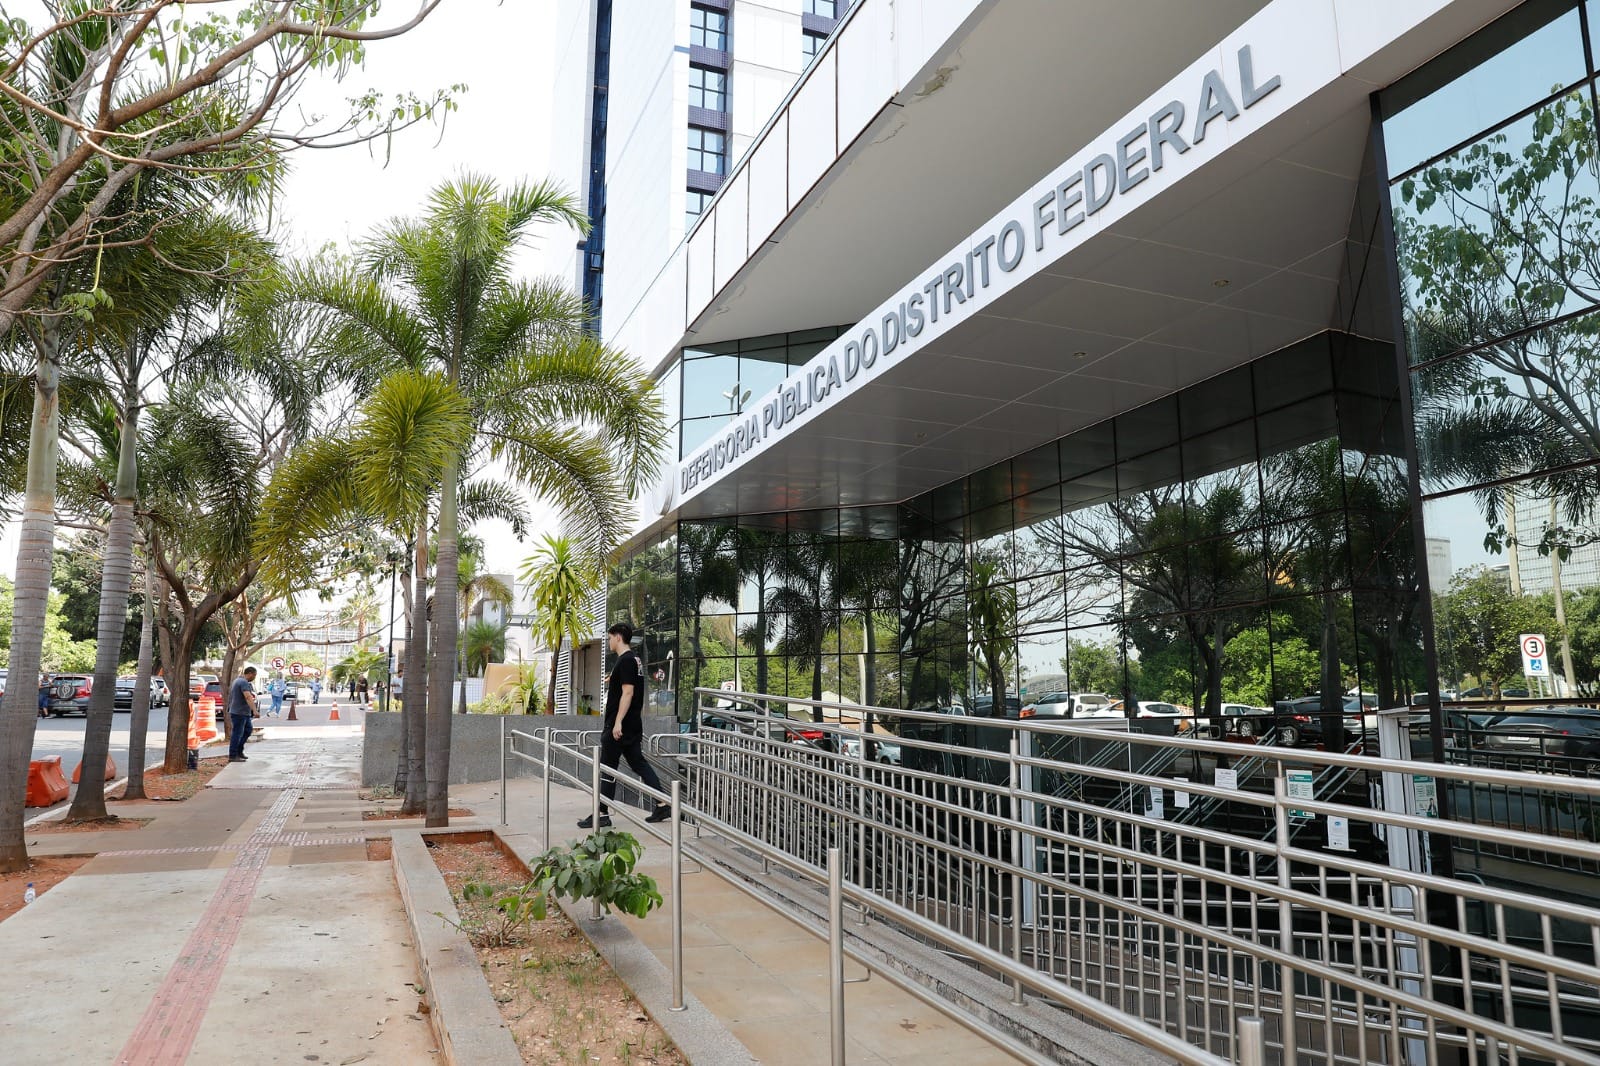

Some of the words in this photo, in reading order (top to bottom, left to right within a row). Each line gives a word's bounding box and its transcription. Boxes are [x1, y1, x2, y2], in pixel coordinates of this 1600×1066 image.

[680, 414, 761, 495] DEFENSORIA
[762, 355, 841, 438] PÚBLICA
[844, 327, 878, 382] DO
[881, 219, 1025, 356] DISTRITO
[1033, 44, 1281, 252] FEDERAL
